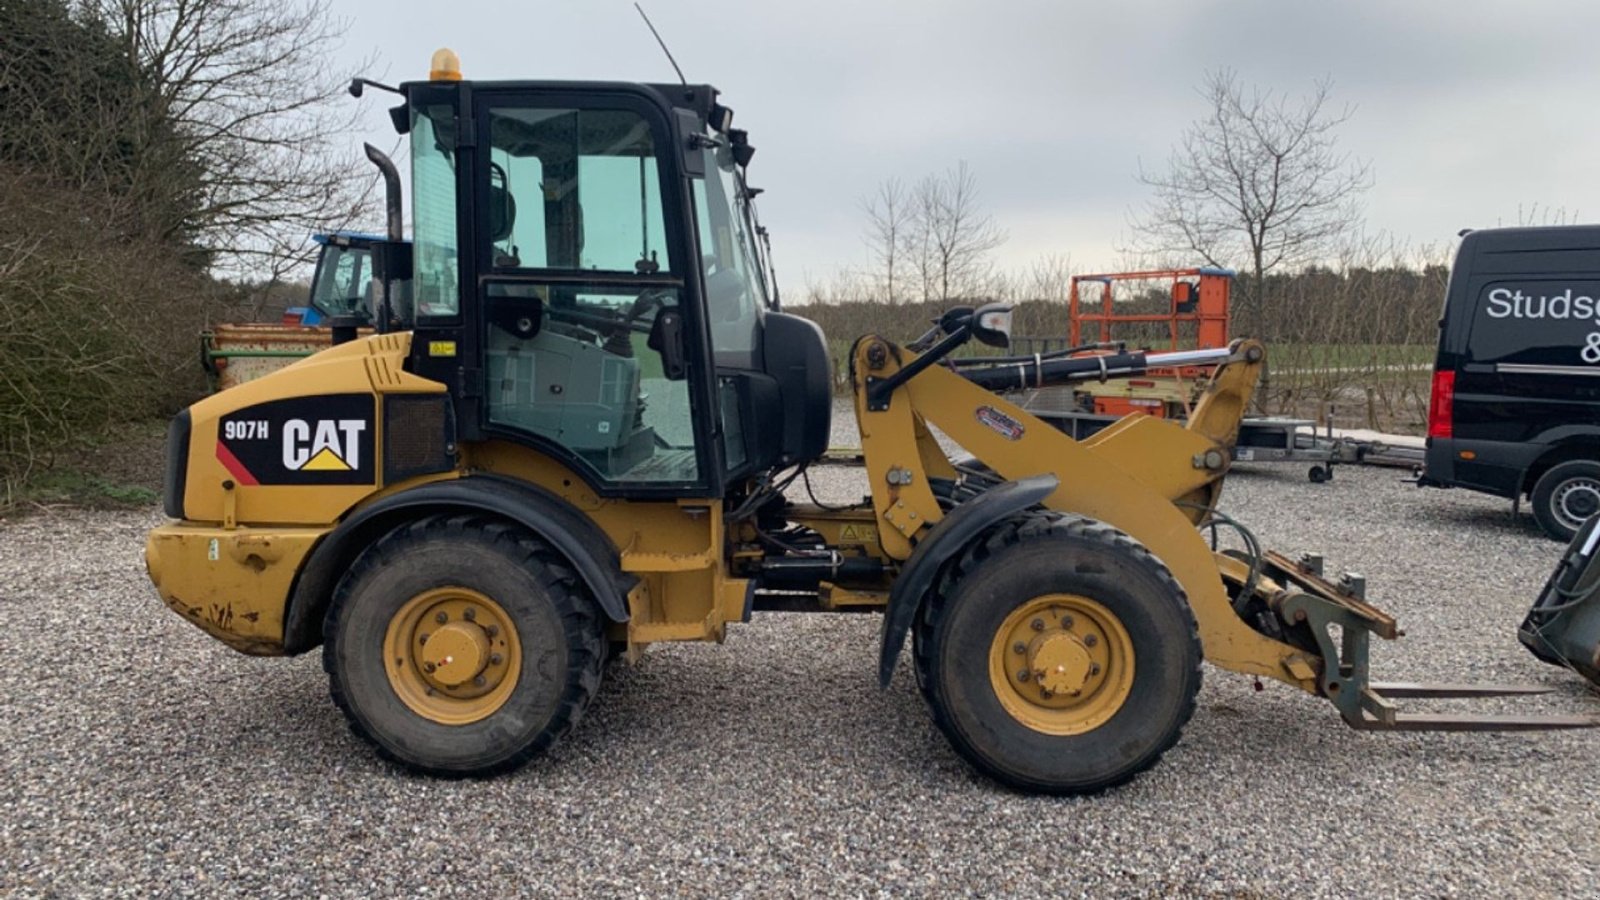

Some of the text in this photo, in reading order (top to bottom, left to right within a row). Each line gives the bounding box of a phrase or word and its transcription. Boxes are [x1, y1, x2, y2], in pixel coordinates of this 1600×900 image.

[1486, 288, 1600, 326] Studs
[1580, 332, 1600, 363] &
[225, 420, 269, 440] 907H
[282, 419, 366, 471] CAT
